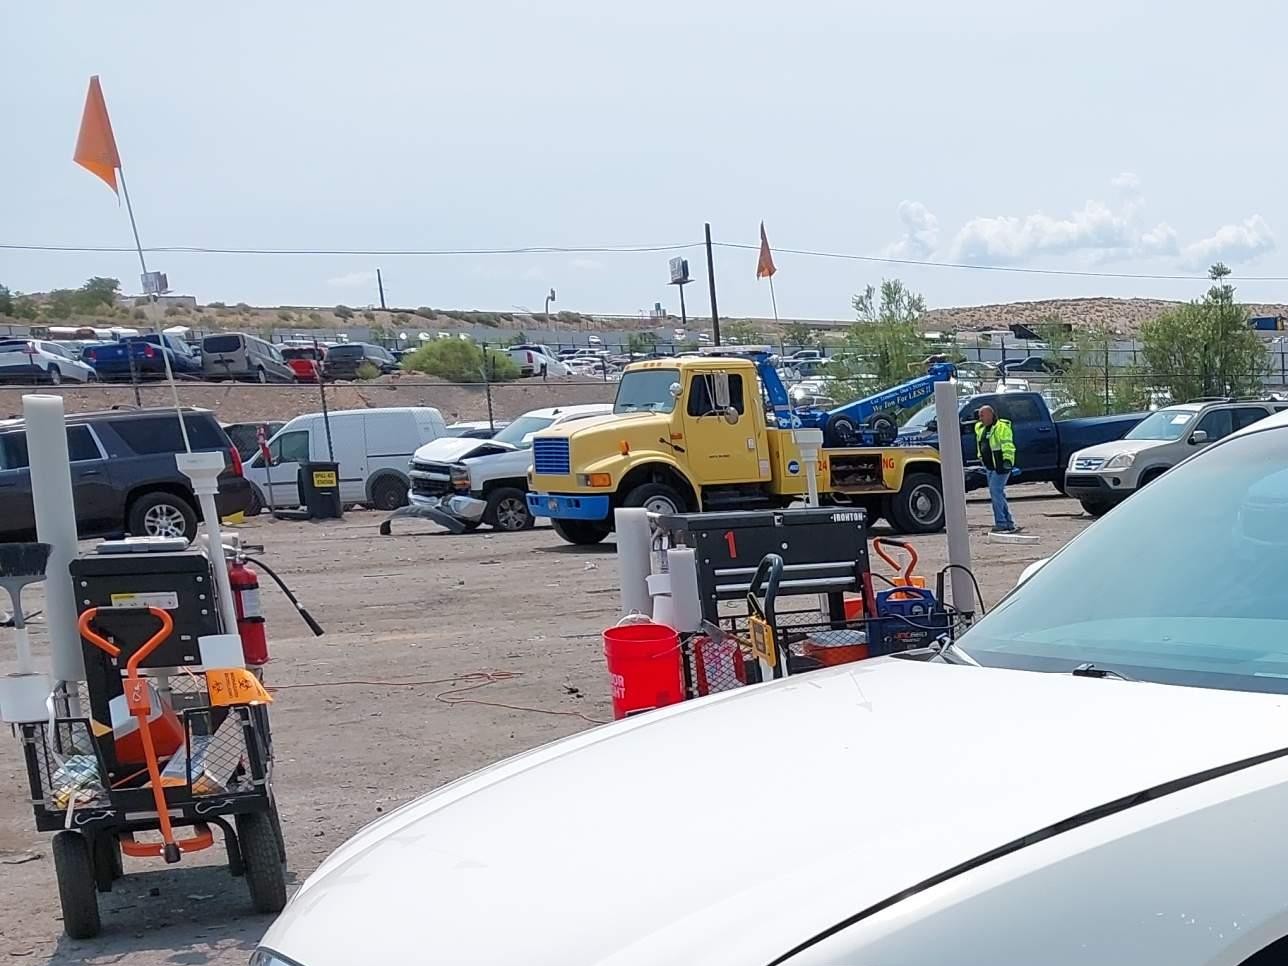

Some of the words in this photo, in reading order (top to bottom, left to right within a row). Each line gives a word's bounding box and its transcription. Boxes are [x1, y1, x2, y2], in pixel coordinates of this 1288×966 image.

[896, 395, 908, 404] For
[908, 388, 925, 400] LESS
[833, 512, 863, 522] IRONTON
[724, 531, 736, 558] 1
